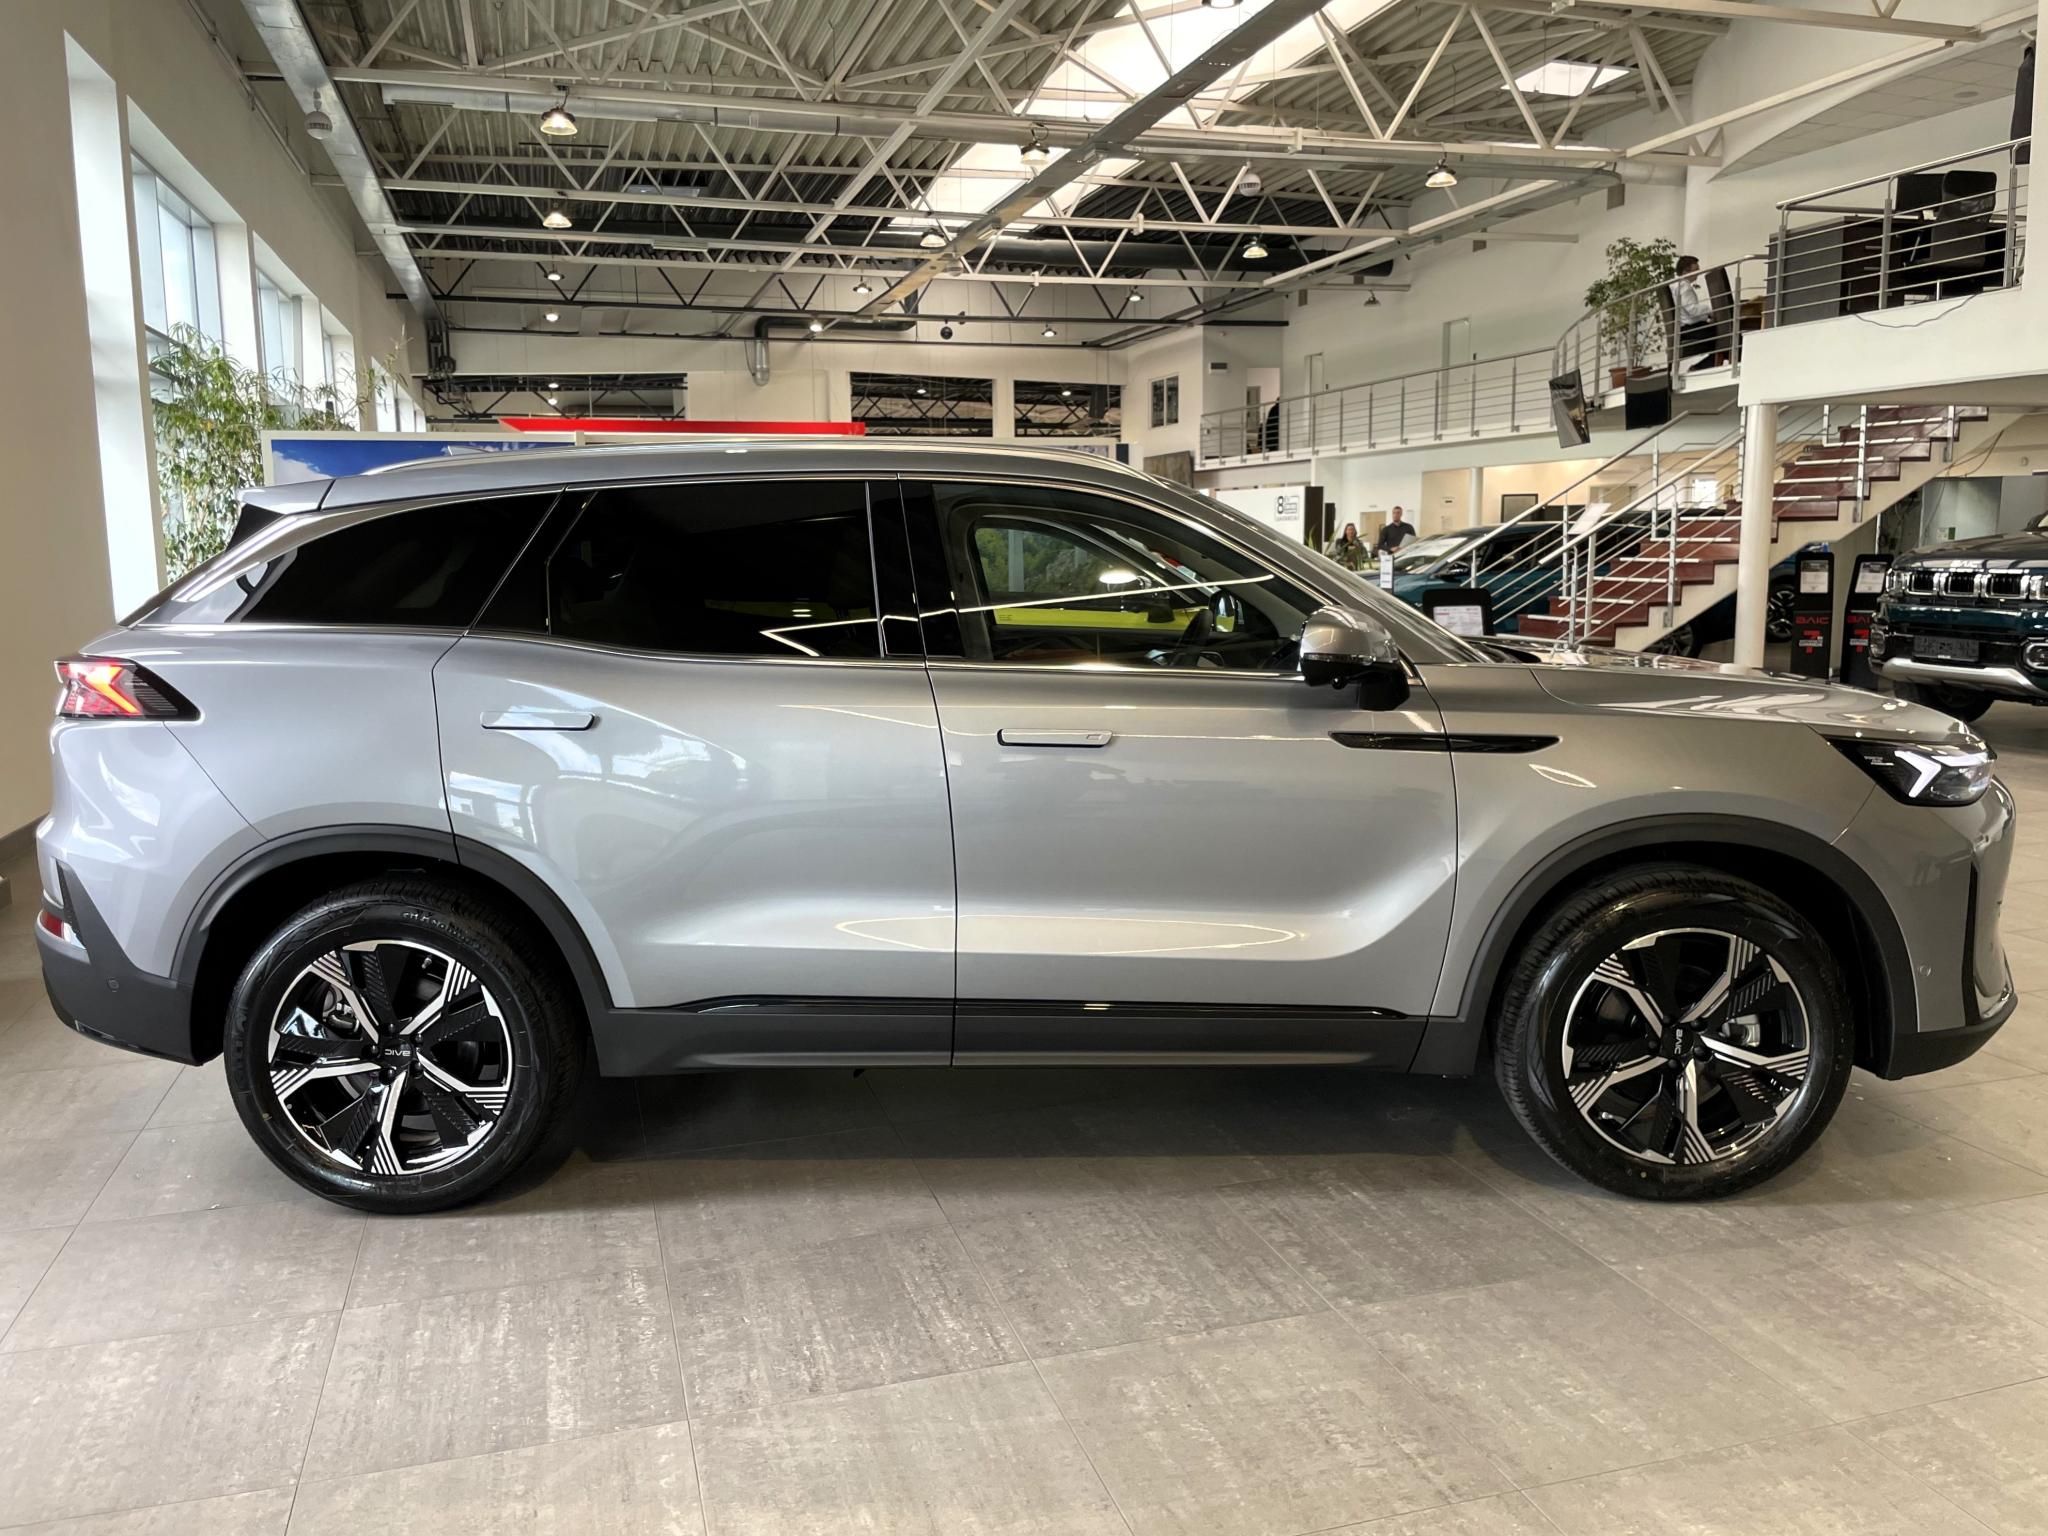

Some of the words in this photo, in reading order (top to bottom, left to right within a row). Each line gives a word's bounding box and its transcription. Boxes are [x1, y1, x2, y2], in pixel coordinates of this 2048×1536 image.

[1795, 616, 1829, 625] BAIC
[1847, 615, 1873, 625] BAI
[1674, 1028, 1683, 1054] BAIC
[384, 1048, 411, 1057] BAIC
